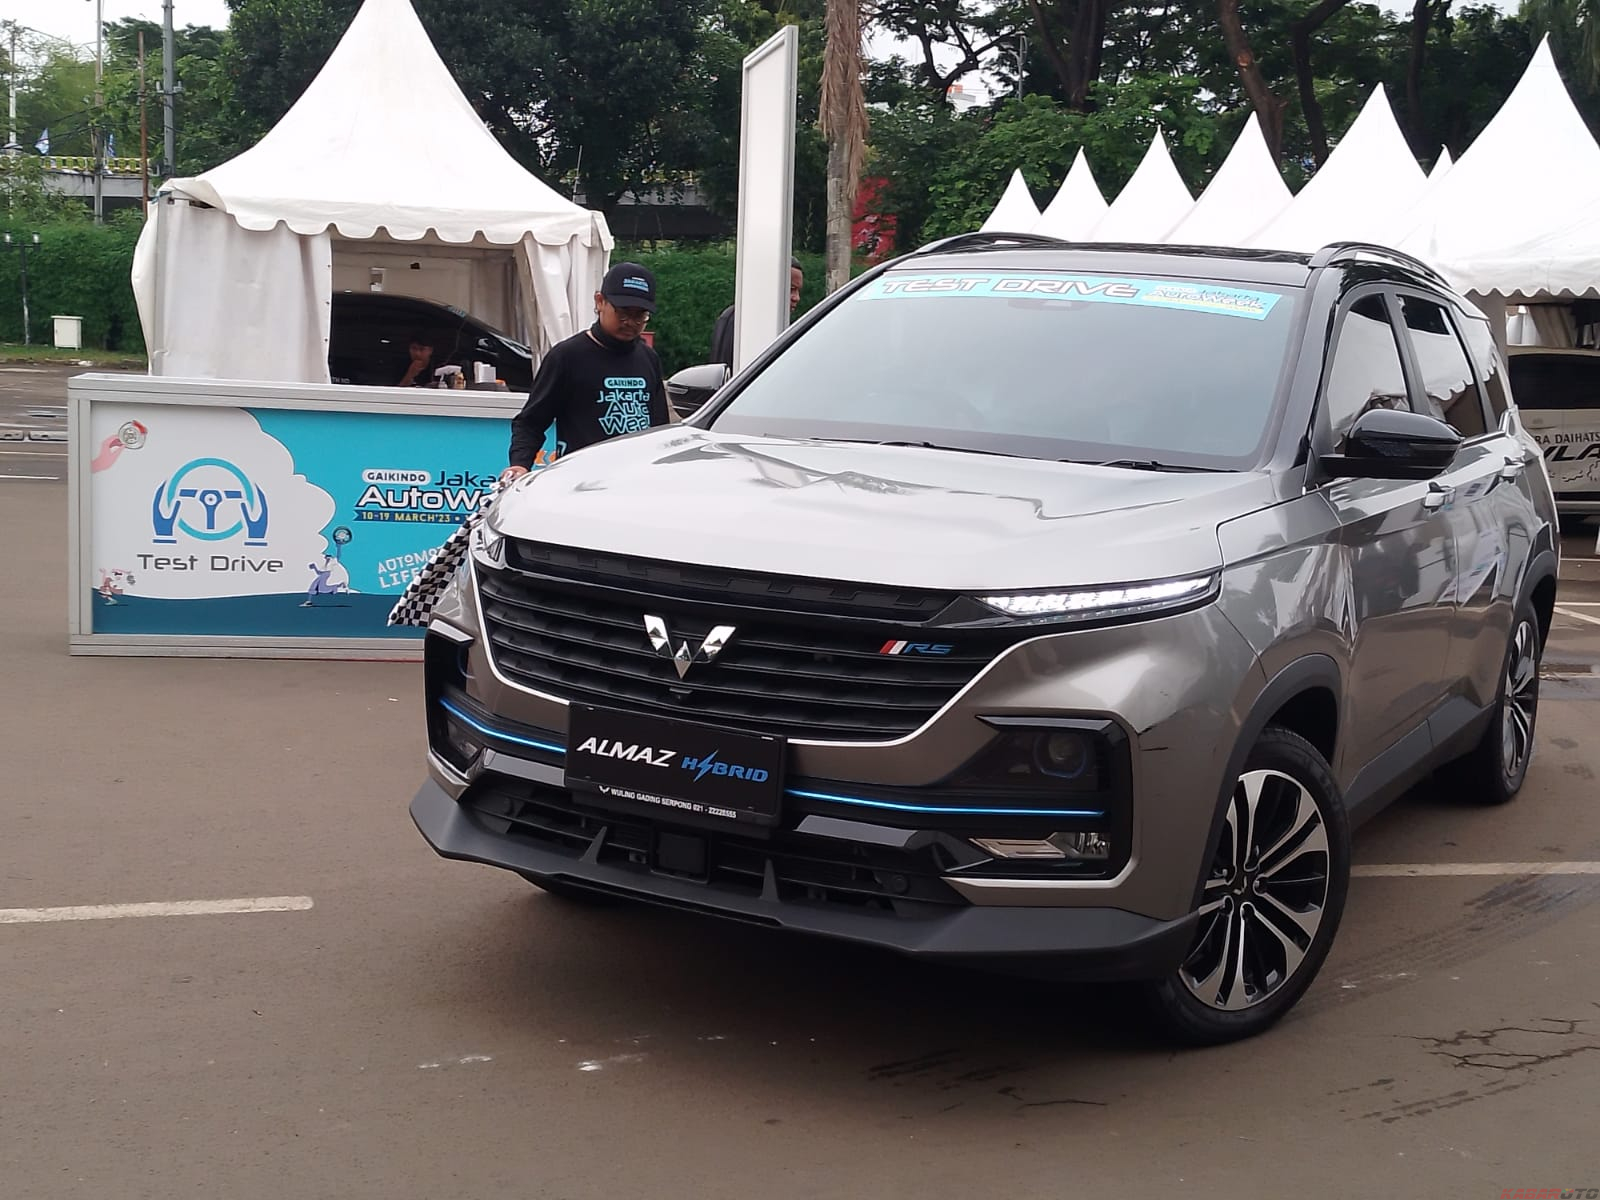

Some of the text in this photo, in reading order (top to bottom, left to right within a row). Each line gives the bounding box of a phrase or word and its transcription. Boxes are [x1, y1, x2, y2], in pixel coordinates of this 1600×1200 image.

[883, 279, 988, 293] TEST
[991, 279, 1139, 298] DRIVE
[597, 389, 650, 402] Jakarta
[598, 415, 650, 434] Wee
[367, 471, 500, 487] GAIKINDO Jaka
[356, 485, 483, 510] AutoW
[362, 512, 451, 522] 10-19 MARCH'23
[137, 554, 283, 572] Test Drive
[903, 643, 954, 654] RS
[577, 737, 677, 768] ALMAZ
